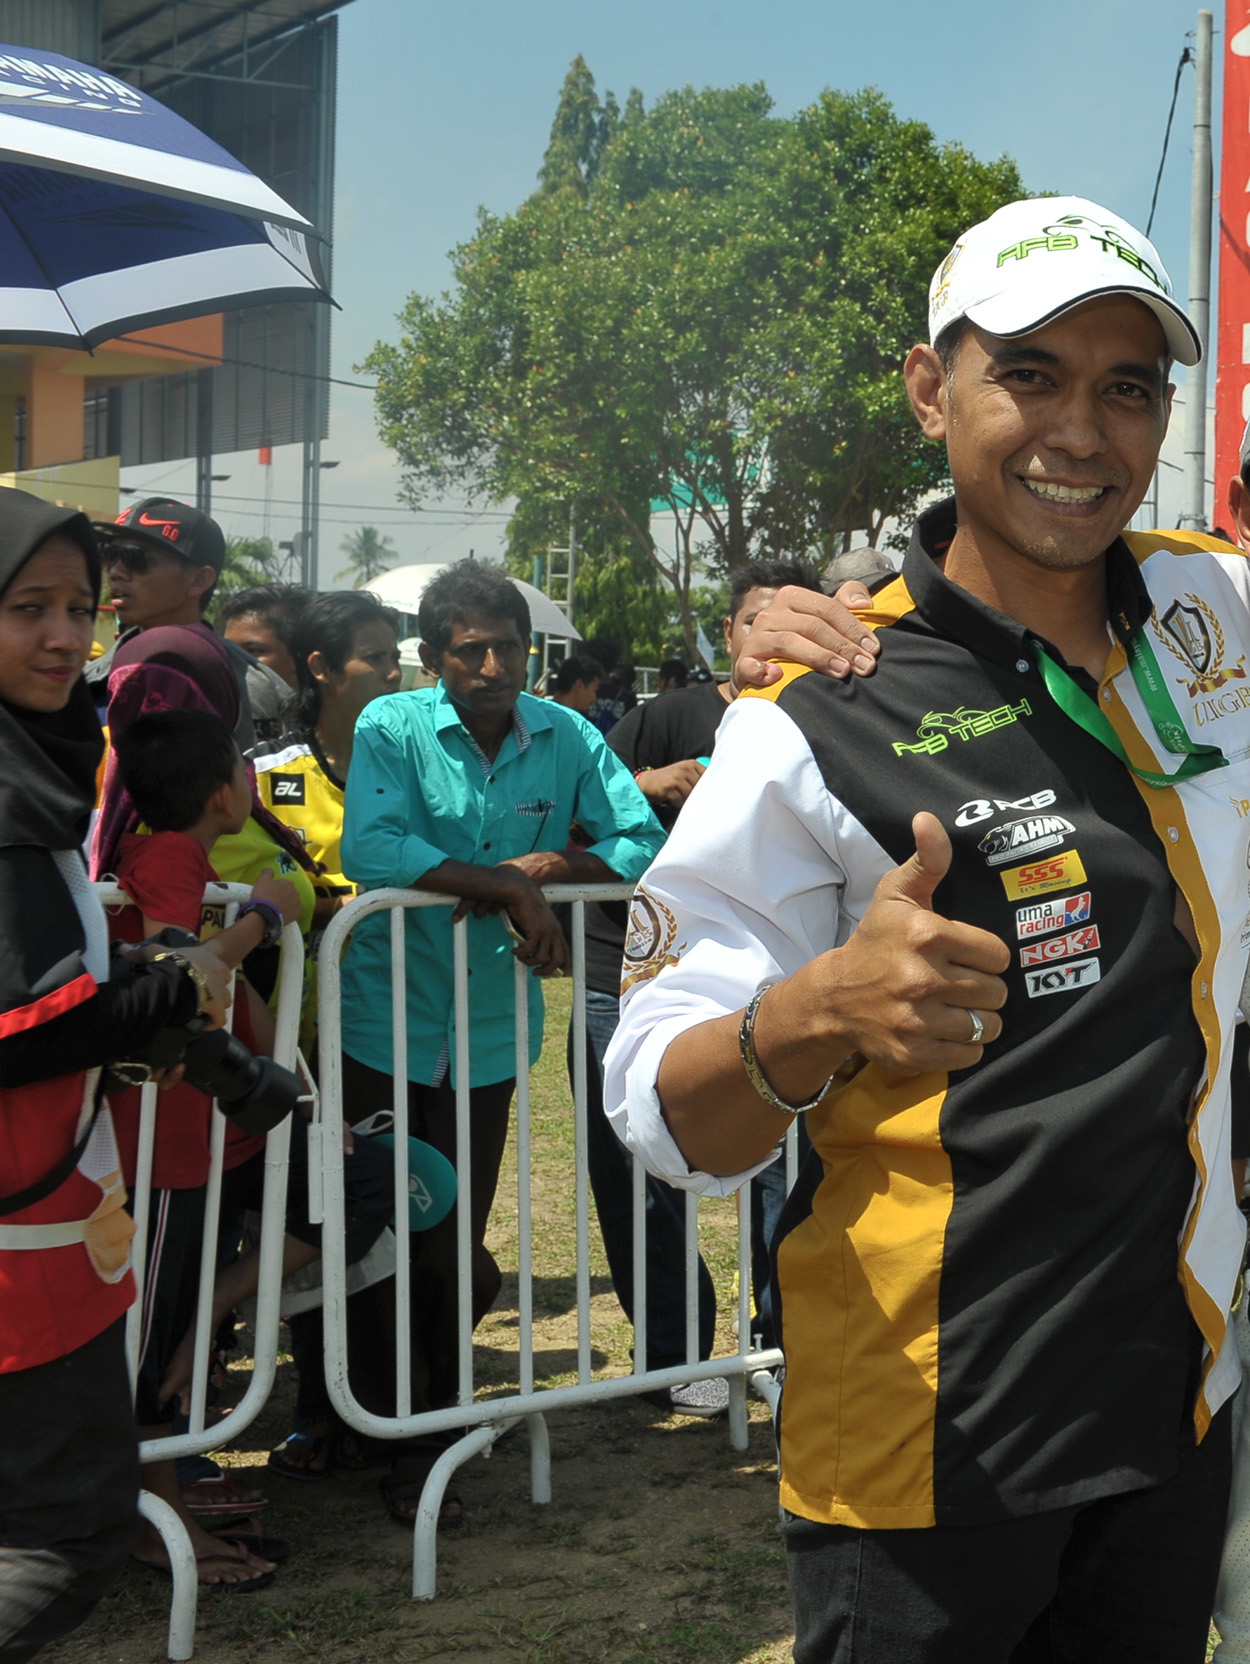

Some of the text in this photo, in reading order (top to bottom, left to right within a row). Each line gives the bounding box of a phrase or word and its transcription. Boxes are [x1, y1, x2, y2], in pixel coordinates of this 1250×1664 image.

[997, 235, 1078, 268] AFB
[949, 698, 1033, 741] TECH
[1012, 818, 1064, 847] AHM
[1018, 856, 1065, 887] SSS
[1040, 878, 1072, 889] Racing
[1018, 904, 1053, 923] uma
[1020, 914, 1064, 935] racing
[1022, 931, 1085, 966] NGK
[1028, 961, 1097, 992] KYT
